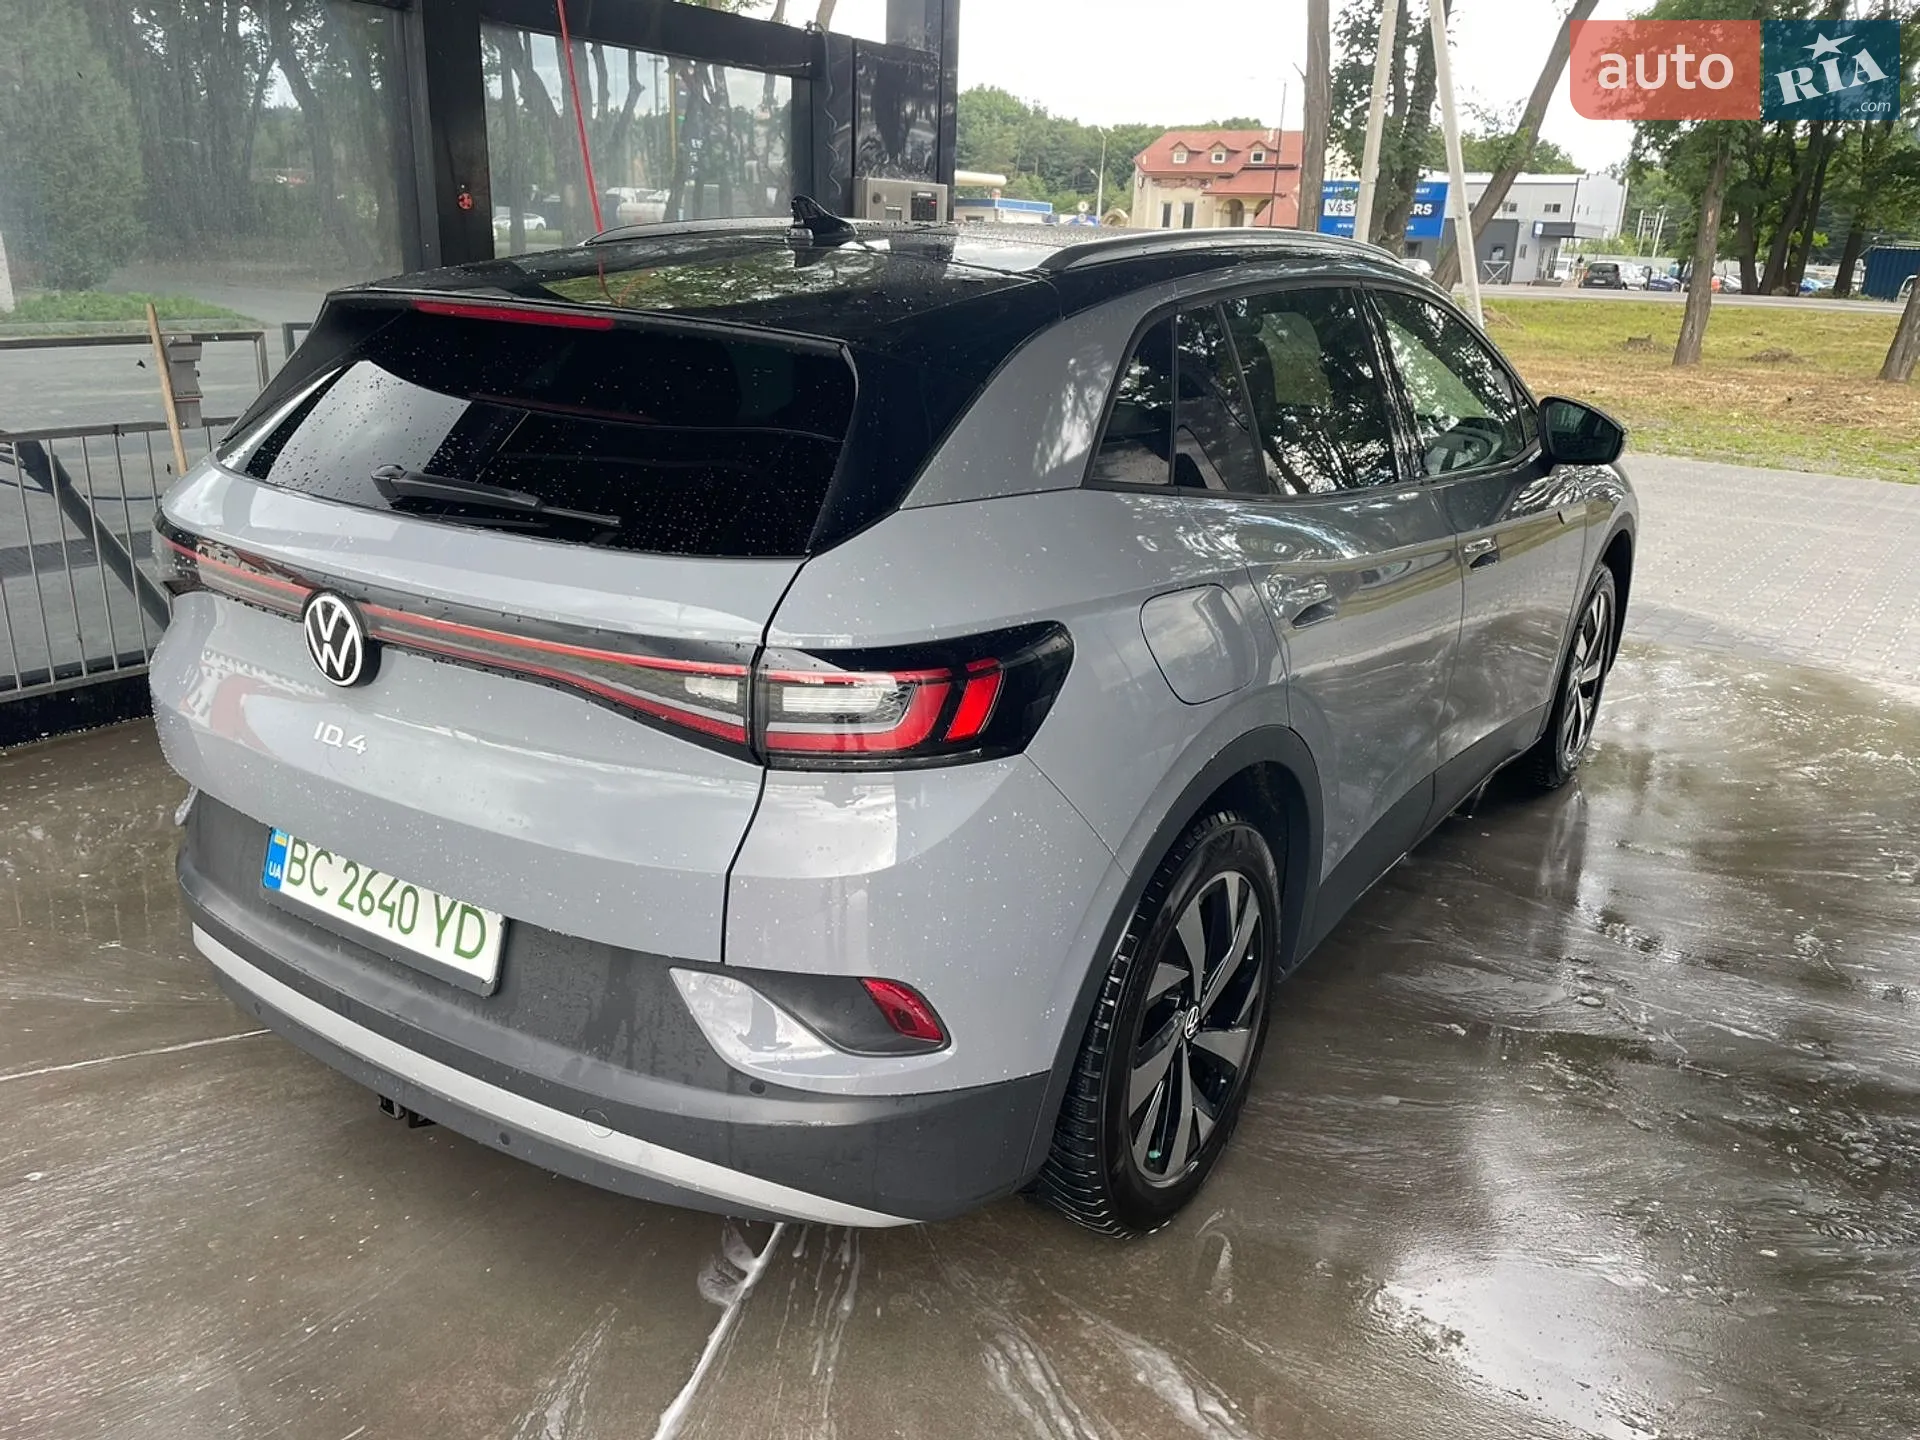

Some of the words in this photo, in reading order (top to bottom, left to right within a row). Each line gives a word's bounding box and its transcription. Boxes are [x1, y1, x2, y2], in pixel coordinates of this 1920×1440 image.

[268, 861, 281, 880] UA
[286, 837, 333, 897] BC
[337, 860, 419, 935] 2640
[433, 893, 486, 960] YD
